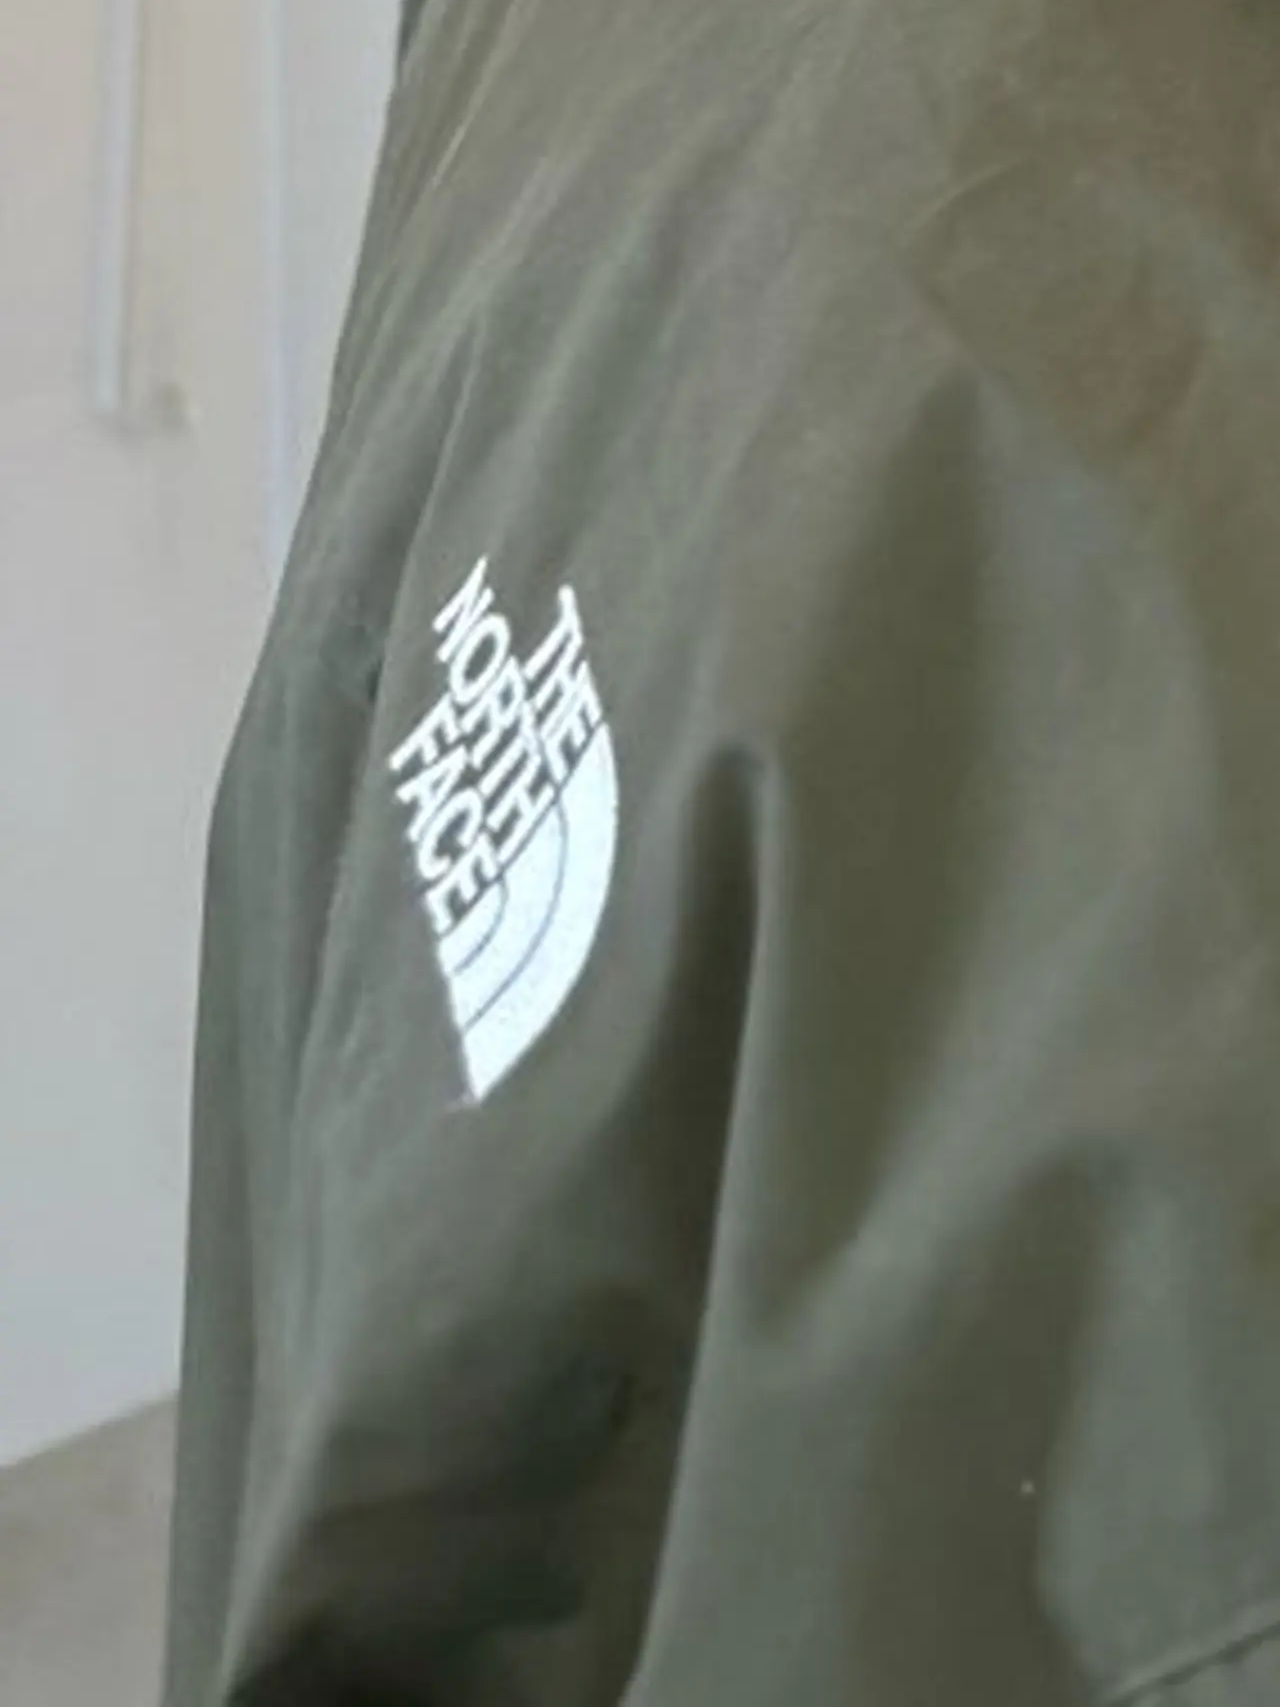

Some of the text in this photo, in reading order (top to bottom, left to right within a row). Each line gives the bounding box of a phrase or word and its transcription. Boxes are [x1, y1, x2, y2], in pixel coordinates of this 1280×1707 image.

[432, 554, 556, 866] NORTH
[525, 584, 602, 786] THE
[389, 692, 499, 935] FACE
